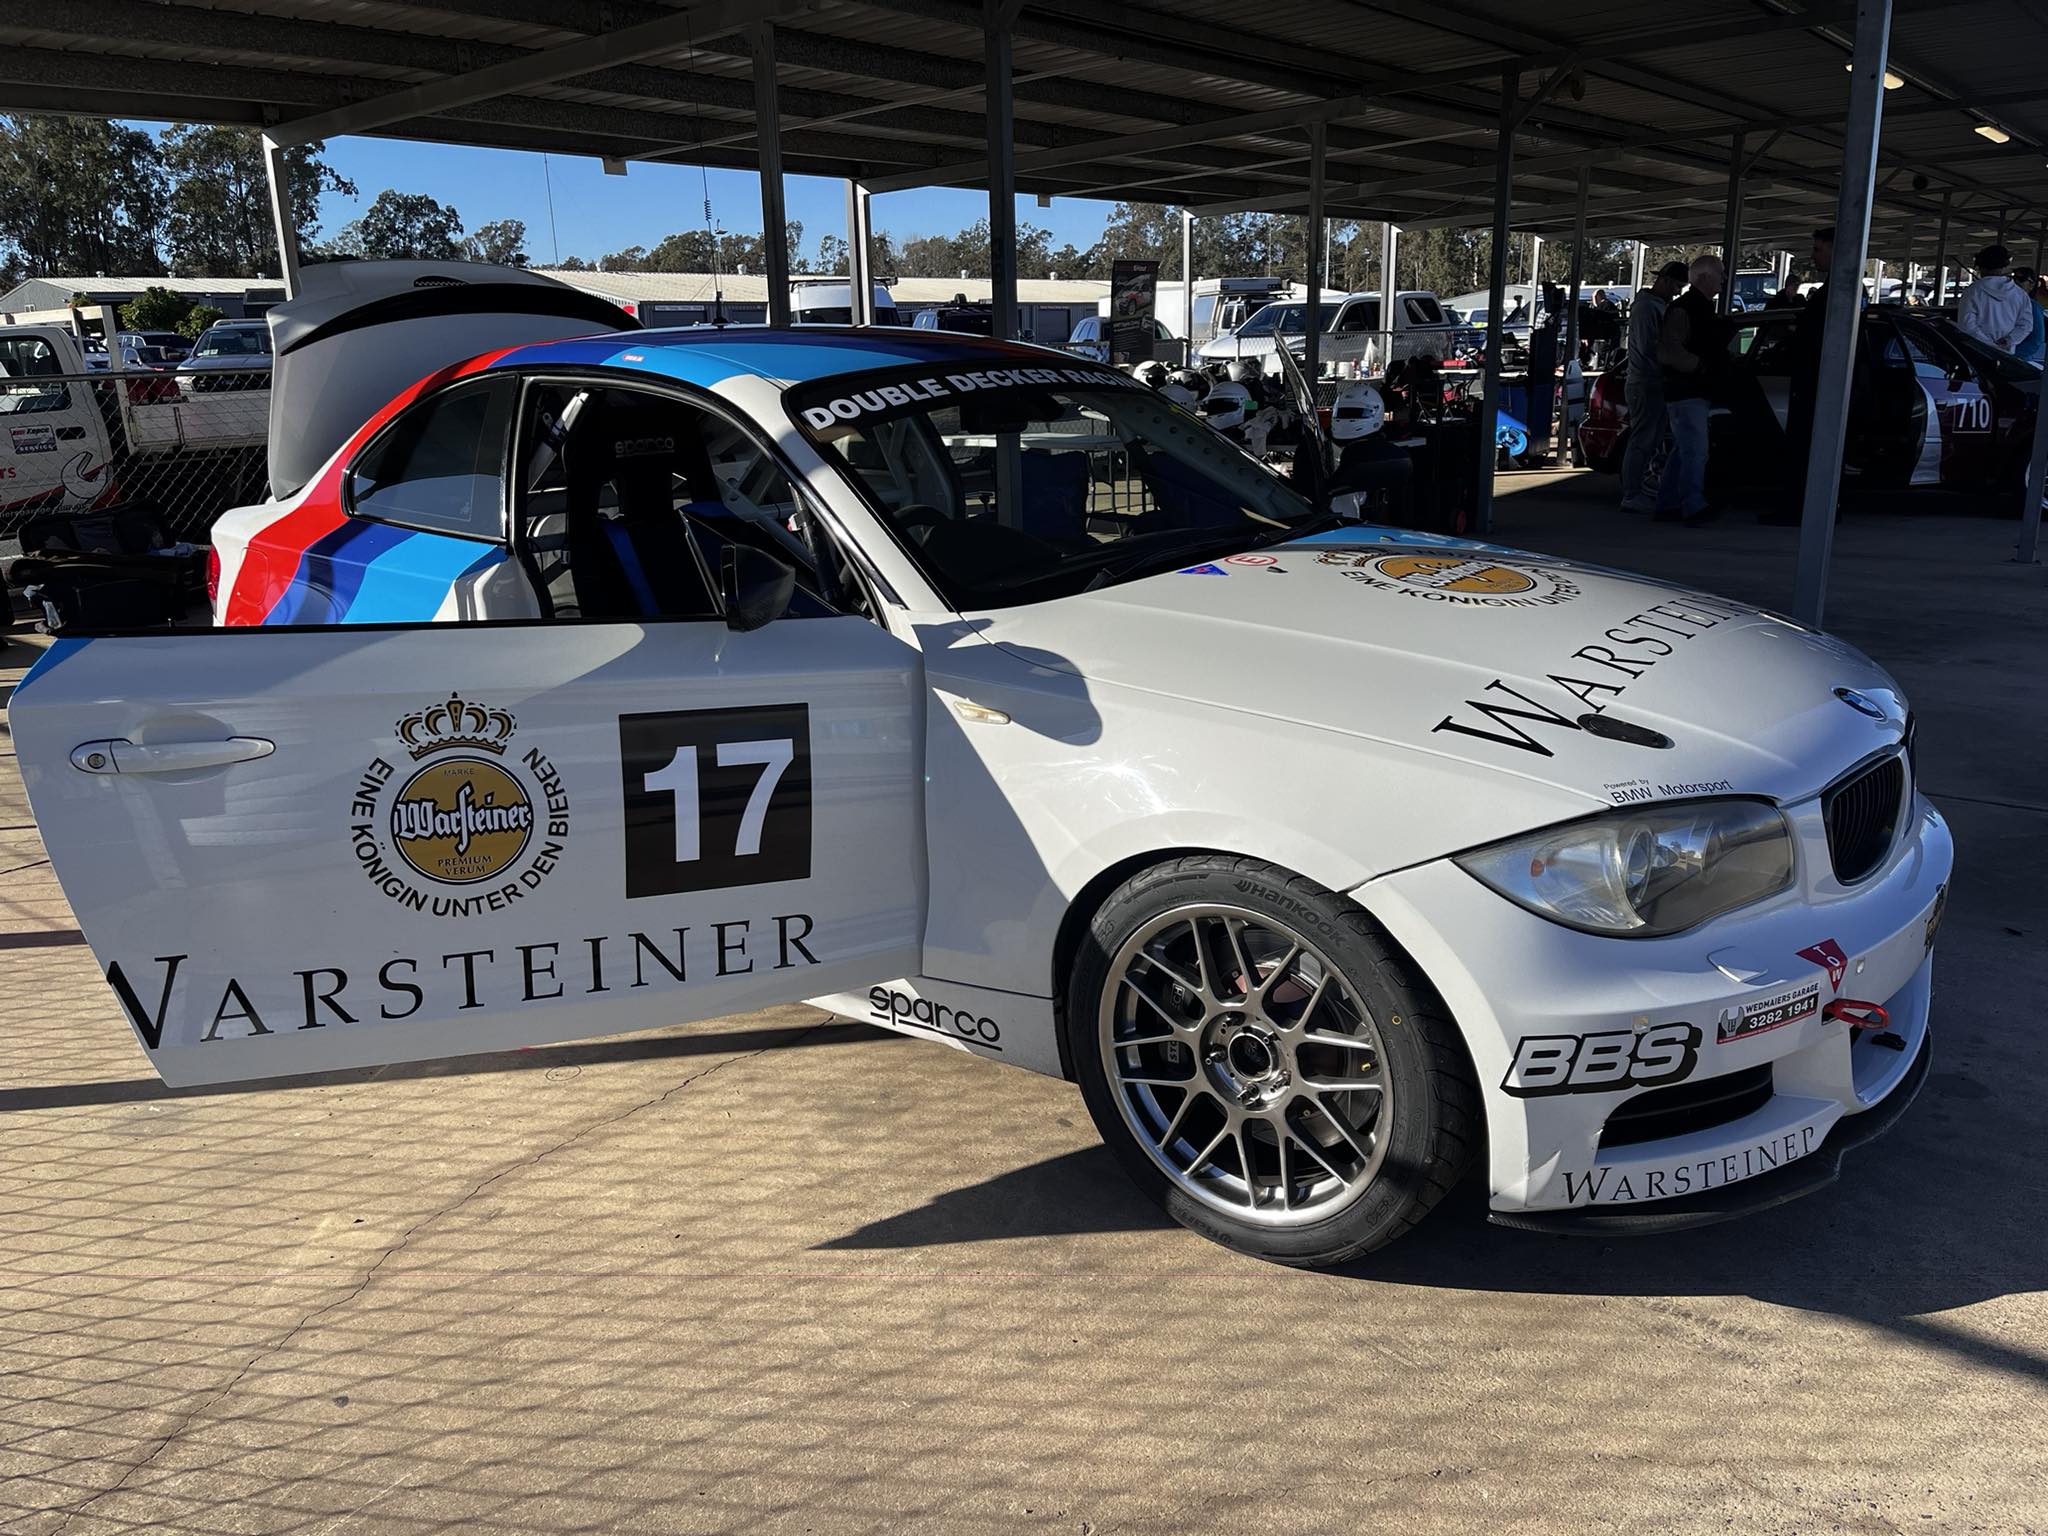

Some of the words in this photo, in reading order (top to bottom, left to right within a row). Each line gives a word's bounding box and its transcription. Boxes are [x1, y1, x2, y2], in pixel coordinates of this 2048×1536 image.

[801, 378, 951, 431] DOUBLE
[945, 368, 1067, 393] DECKER
[1957, 398, 1990, 429] 710
[1340, 570, 1400, 591] EINE
[351, 757, 395, 819] EINE
[443, 767, 476, 777] MARKE
[1603, 779, 1637, 791] Powered
[1639, 778, 1650, 786] by
[521, 746, 570, 838] BIEREN
[643, 738, 794, 862] 17
[1610, 786, 1653, 803] BMW
[1657, 779, 1734, 797] Motorsport
[393, 780, 532, 856] Warsteiner
[351, 823, 429, 912] KÖNIGIN
[437, 854, 493, 868] PREMIUM
[444, 864, 487, 876] VERUM
[520, 841, 564, 890] DEN
[432, 882, 525, 918] UNTER
[1813, 945, 1843, 983] TOW
[1745, 993, 1791, 1014] WEDMAIERS
[1792, 983, 1819, 1000] GARAGE
[1749, 1009, 1783, 1029] 3282
[1787, 997, 1815, 1017] 1941
[869, 986, 1003, 1050] sparco
[1500, 1022, 1702, 1097] BBS
